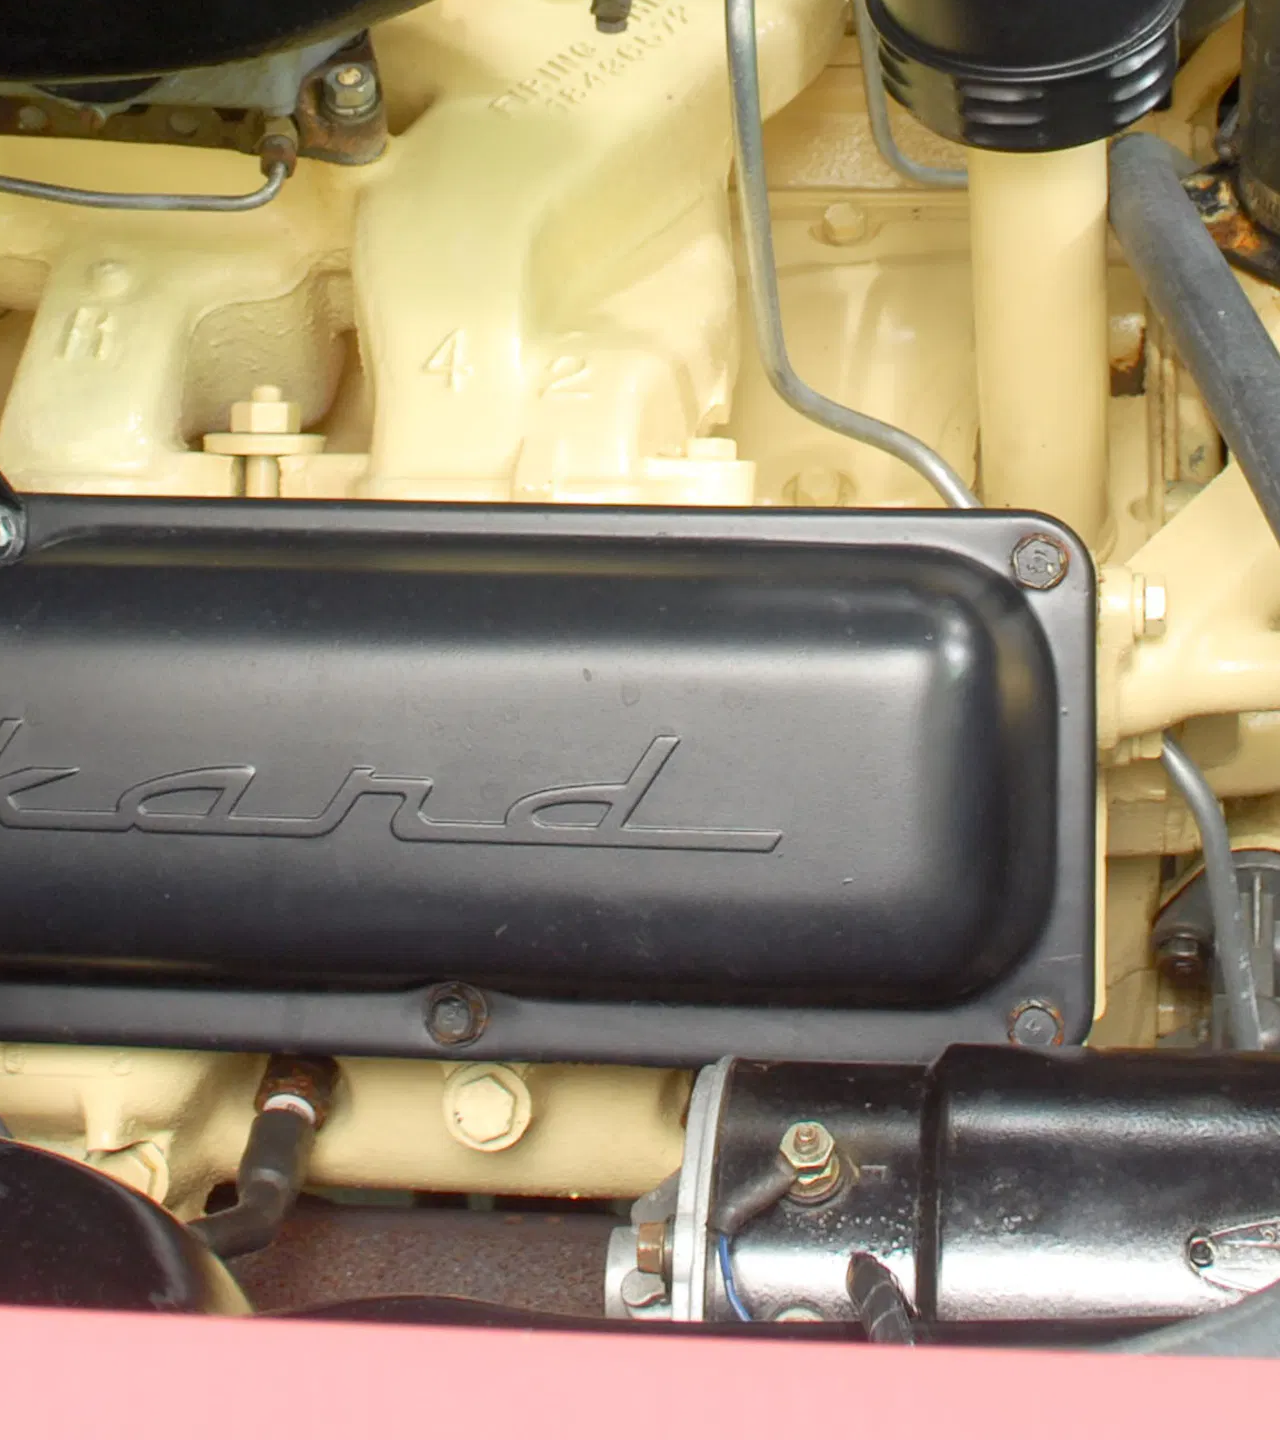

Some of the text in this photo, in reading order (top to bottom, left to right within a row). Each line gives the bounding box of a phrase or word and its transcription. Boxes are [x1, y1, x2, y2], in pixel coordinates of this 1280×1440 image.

[487, 40, 597, 117] FIRING
[420, 327, 474, 393] 4
[537, 354, 593, 401] 2
